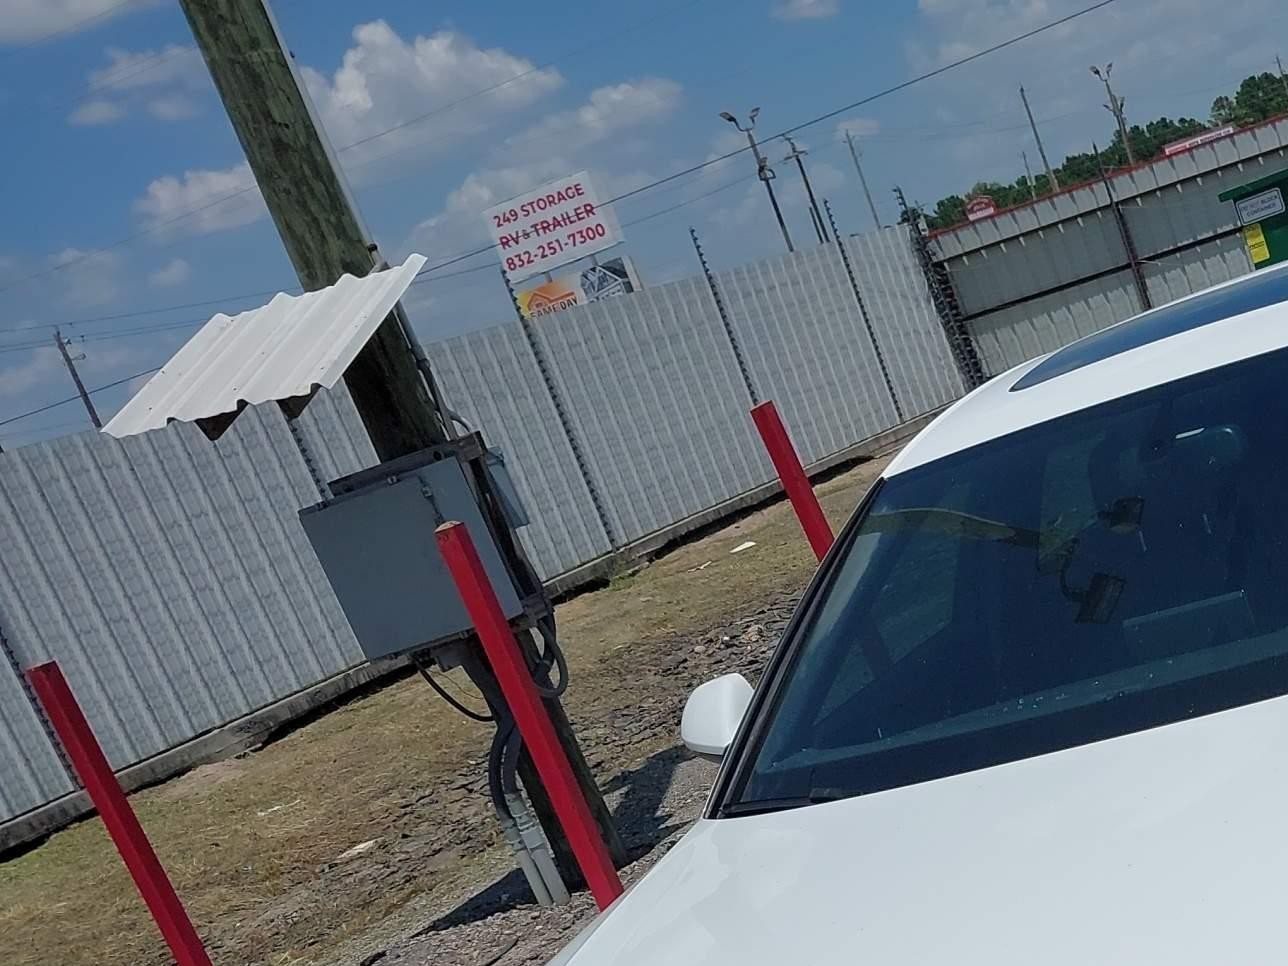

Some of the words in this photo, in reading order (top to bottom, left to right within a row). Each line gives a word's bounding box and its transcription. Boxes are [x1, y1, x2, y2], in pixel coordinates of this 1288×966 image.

[493, 208, 519, 228] 249
[520, 183, 585, 218] STORAGE
[499, 232, 520, 250] RV
[531, 203, 596, 237] TRAILER
[506, 223, 606, 271] 832-251-7300
[560, 296, 578, 310] DAY
